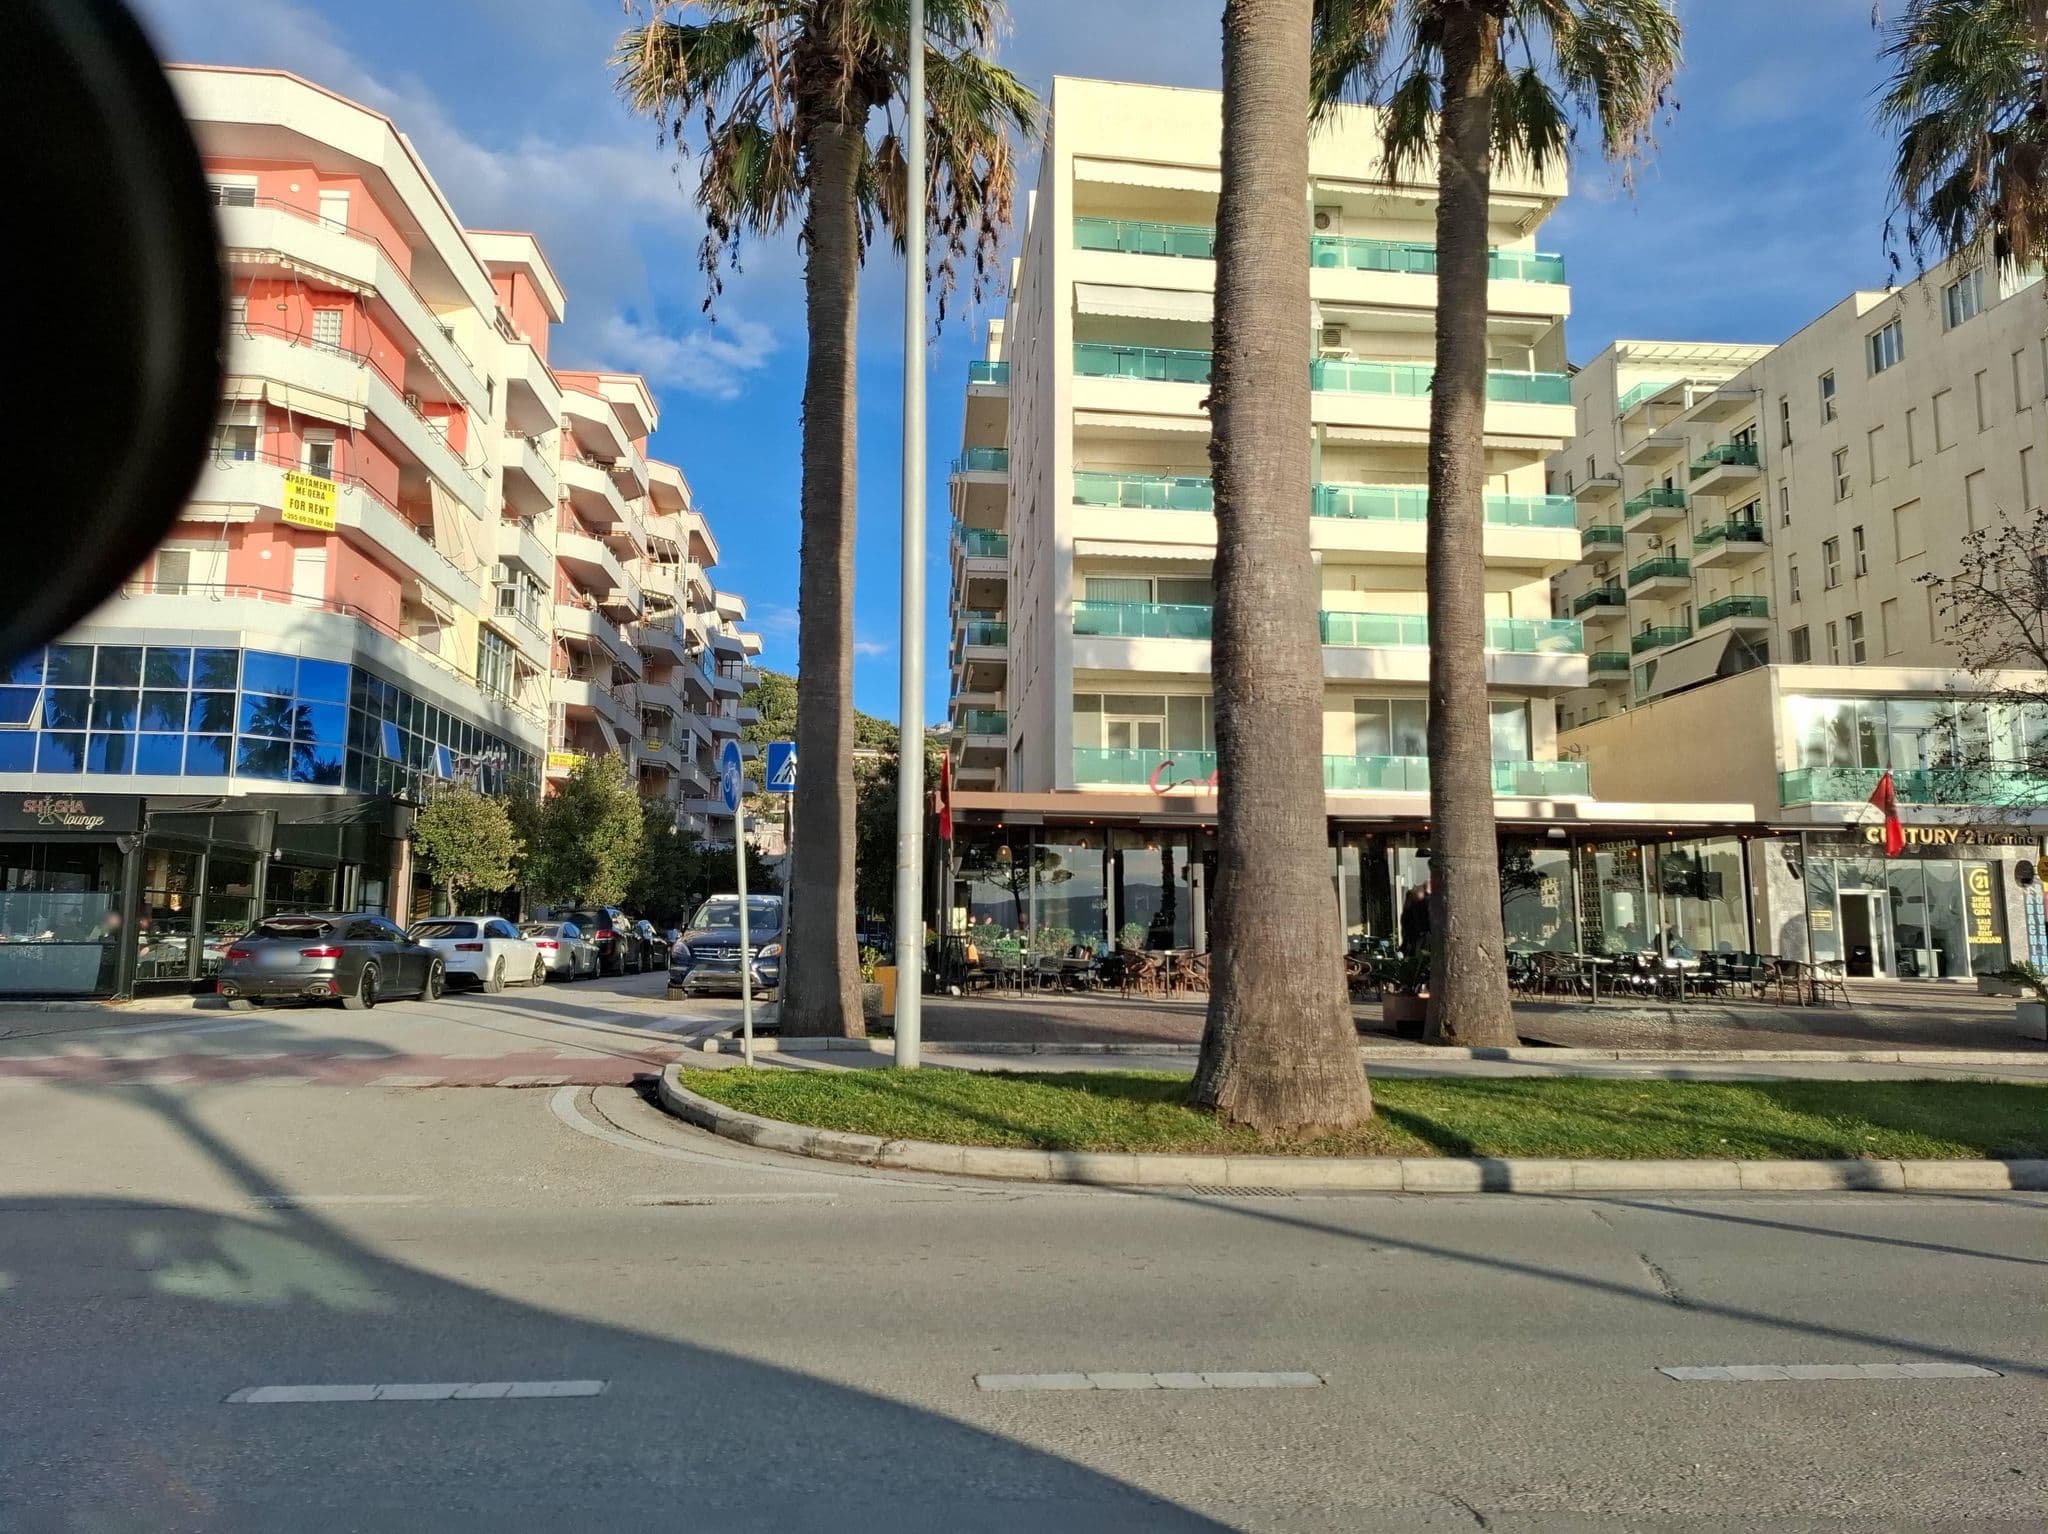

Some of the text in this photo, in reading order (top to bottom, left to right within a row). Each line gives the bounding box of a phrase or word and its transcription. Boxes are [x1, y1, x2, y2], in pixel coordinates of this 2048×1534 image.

[295, 486, 306, 496] ME
[289, 498, 330, 516] FOR RENT
[63, 813, 105, 830] lounge
[1965, 829, 1982, 844] 21
